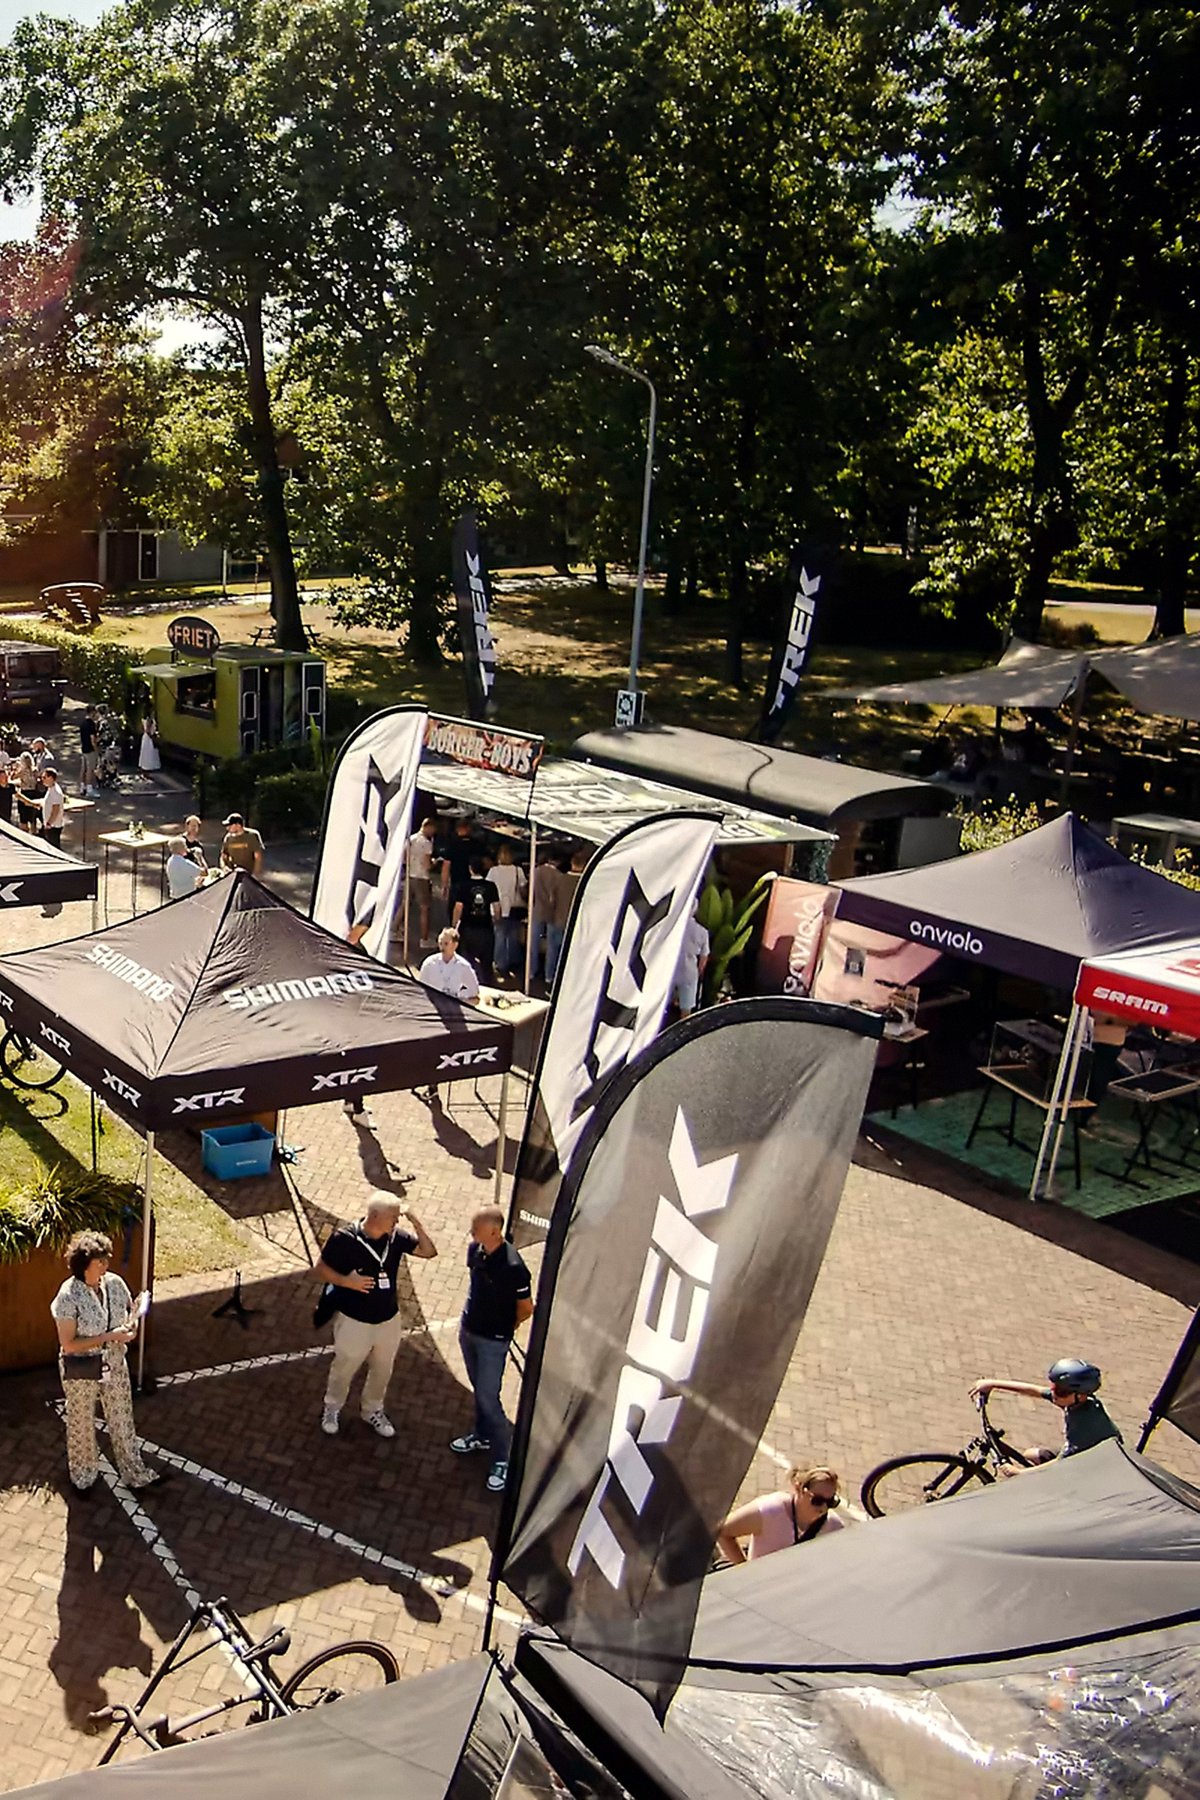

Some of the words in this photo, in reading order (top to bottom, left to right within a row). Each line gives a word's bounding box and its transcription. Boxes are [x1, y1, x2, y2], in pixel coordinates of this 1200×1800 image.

[174, 625, 212, 649] FRIET
[465, 550, 496, 696] TREK
[768, 566, 821, 715] TREK
[910, 919, 983, 954] enviolo
[85, 944, 176, 1002] SHIMANO
[222, 969, 375, 1011] SHIMANO
[1092, 986, 1169, 1015] SRAM
[40, 1021, 72, 1056] XTR
[436, 1046, 499, 1071] XTR
[101, 1067, 142, 1109] XTR
[311, 1065, 379, 1092] XTR
[171, 1086, 247, 1115] XTR
[568, 1105, 738, 1589] TREK
